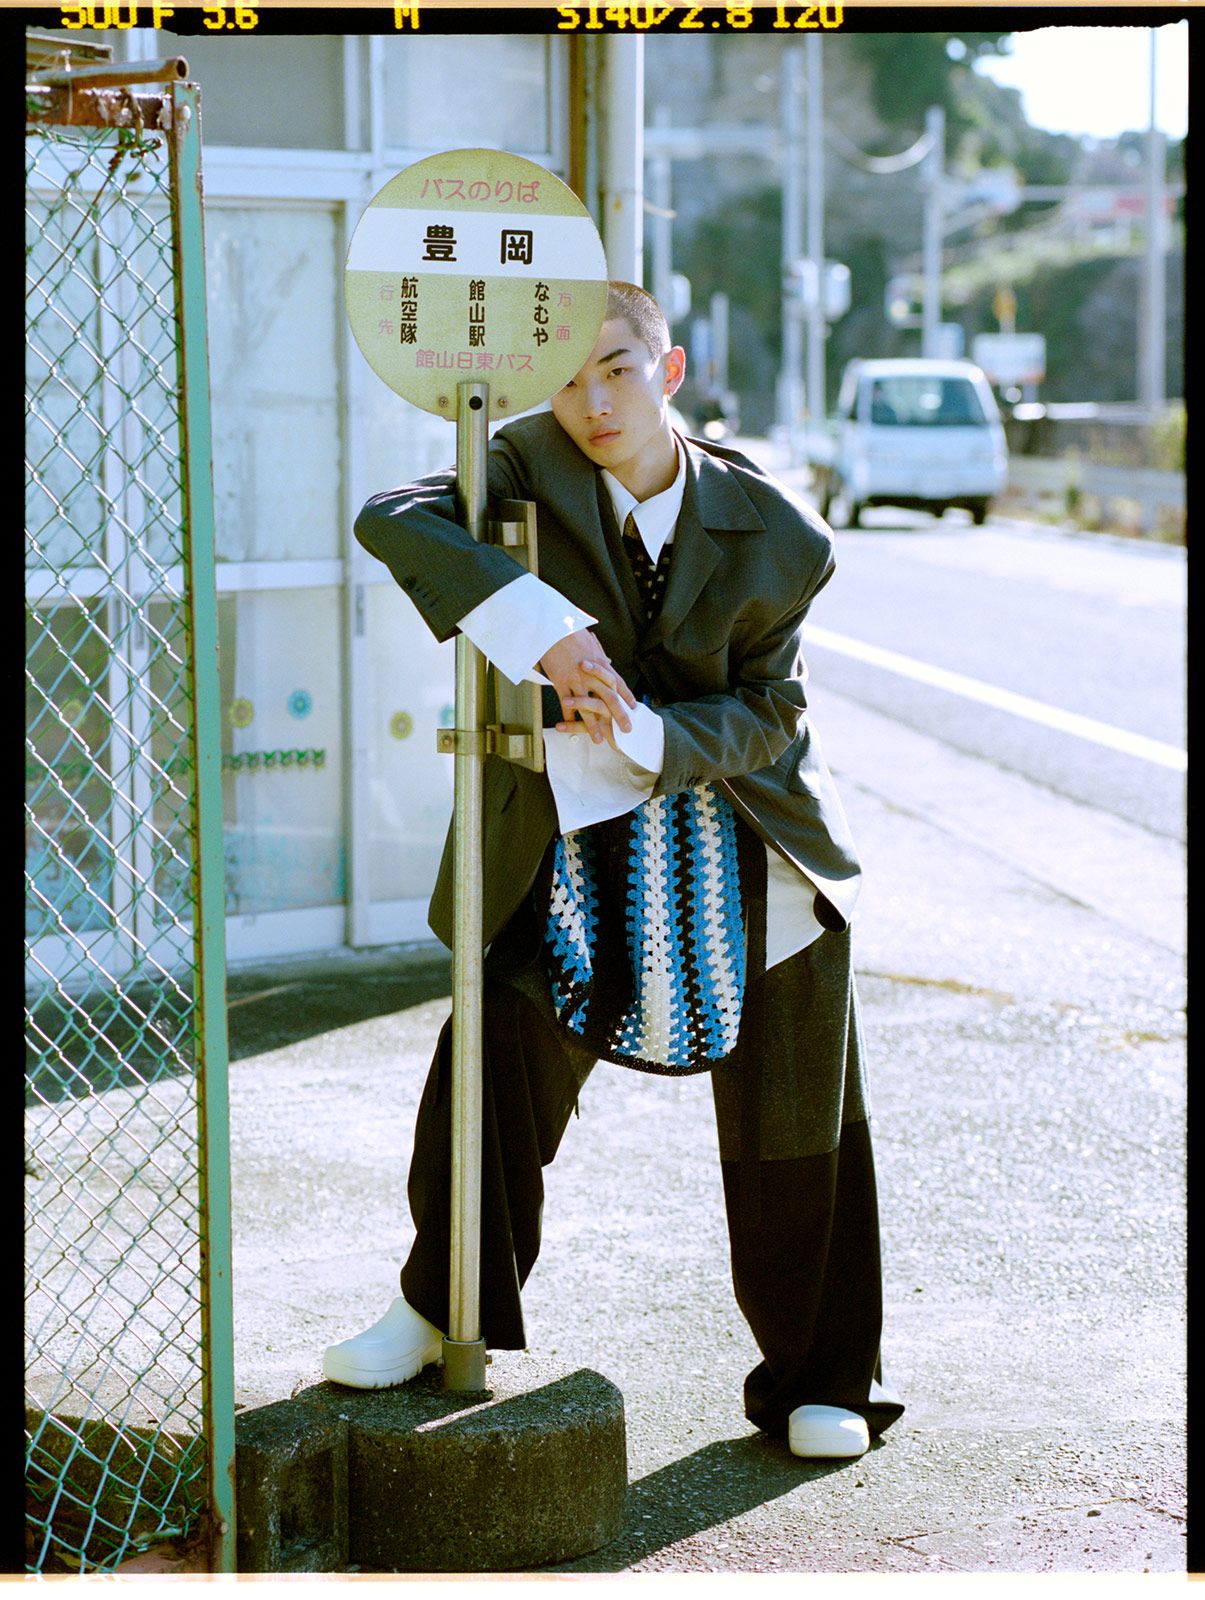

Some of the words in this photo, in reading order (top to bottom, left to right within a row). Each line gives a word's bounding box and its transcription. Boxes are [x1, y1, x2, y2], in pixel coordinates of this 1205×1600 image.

[420, 178, 541, 204] バスのりば
[422, 224, 534, 265] 豊岡
[400, 276, 419, 345] 航空隊
[468, 279, 486, 347] 館山駅
[532, 281, 550, 347] なむや
[415, 349, 535, 373] 館山日東バス
